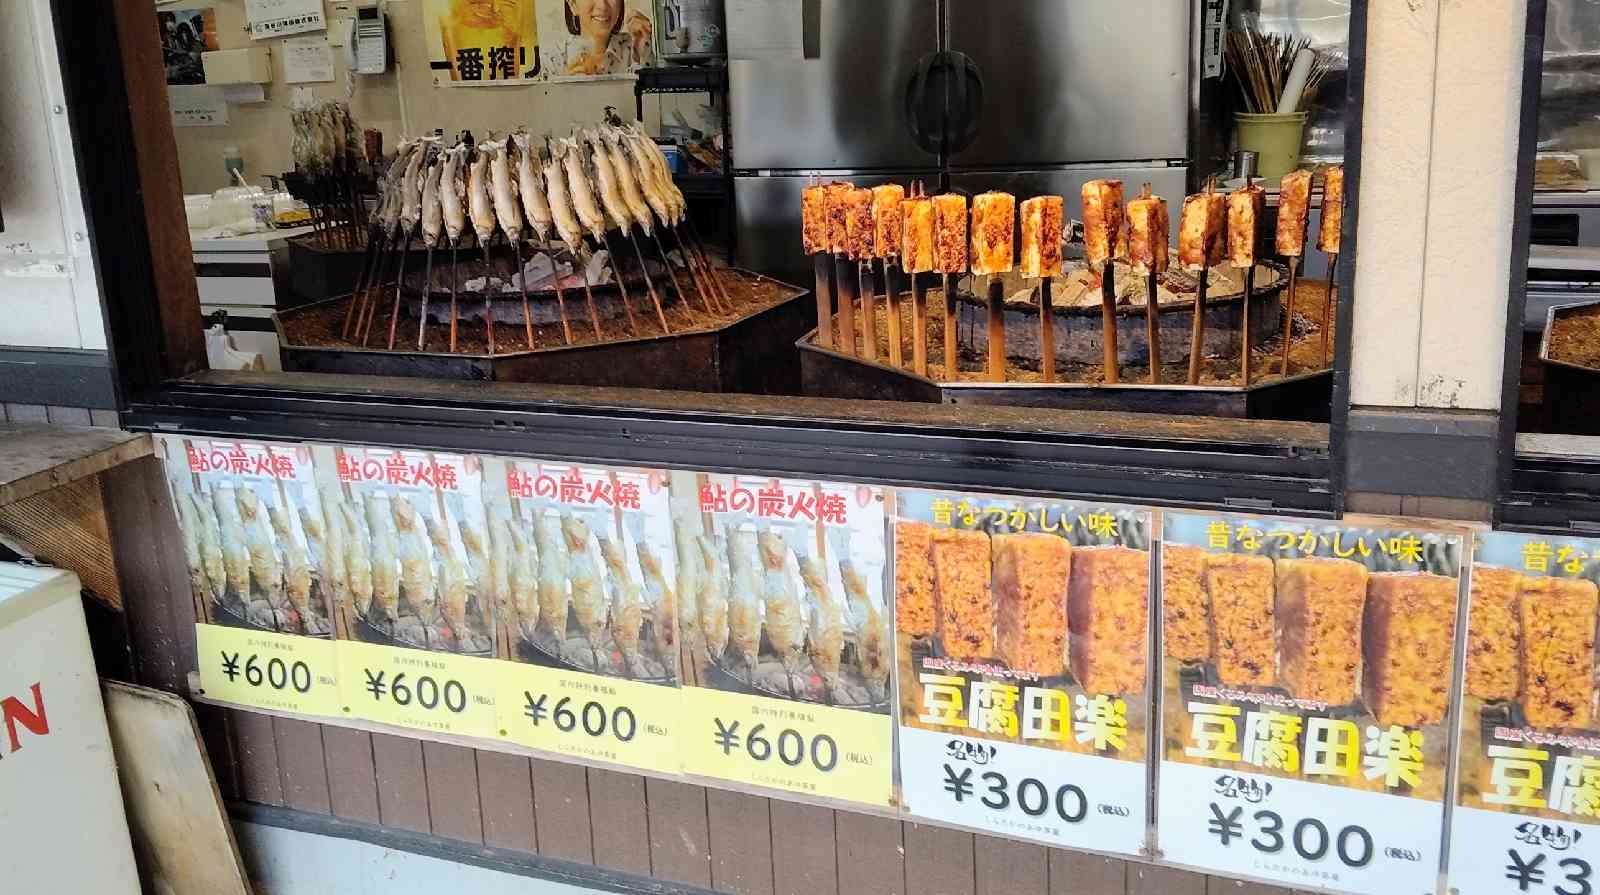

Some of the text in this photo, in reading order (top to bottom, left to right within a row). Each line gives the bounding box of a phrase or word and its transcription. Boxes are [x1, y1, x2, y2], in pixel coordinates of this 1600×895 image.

[430, 46, 541, 80] 一番搾り
[190, 446, 296, 479] 鮎の炭火焼
[337, 452, 458, 490] 鮎の炭火焼
[507, 466, 642, 510] 鮎の炭火焼
[699, 478, 848, 525] 鮎の炭火焼
[932, 498, 1120, 539] 昔なつかしい味
[1206, 519, 1427, 565] 昔なつかしい味
[221, 650, 311, 693] ¥600
[364, 667, 466, 713] ¥600
[524, 690, 636, 742] ¥600
[919, 672, 1128, 752] 豆腐田楽
[713, 717, 838, 772] ¥600
[1185, 700, 1426, 789] 豆腐田楽
[943, 763, 1088, 824] ¥300
[1208, 801, 1374, 868] ¥300
